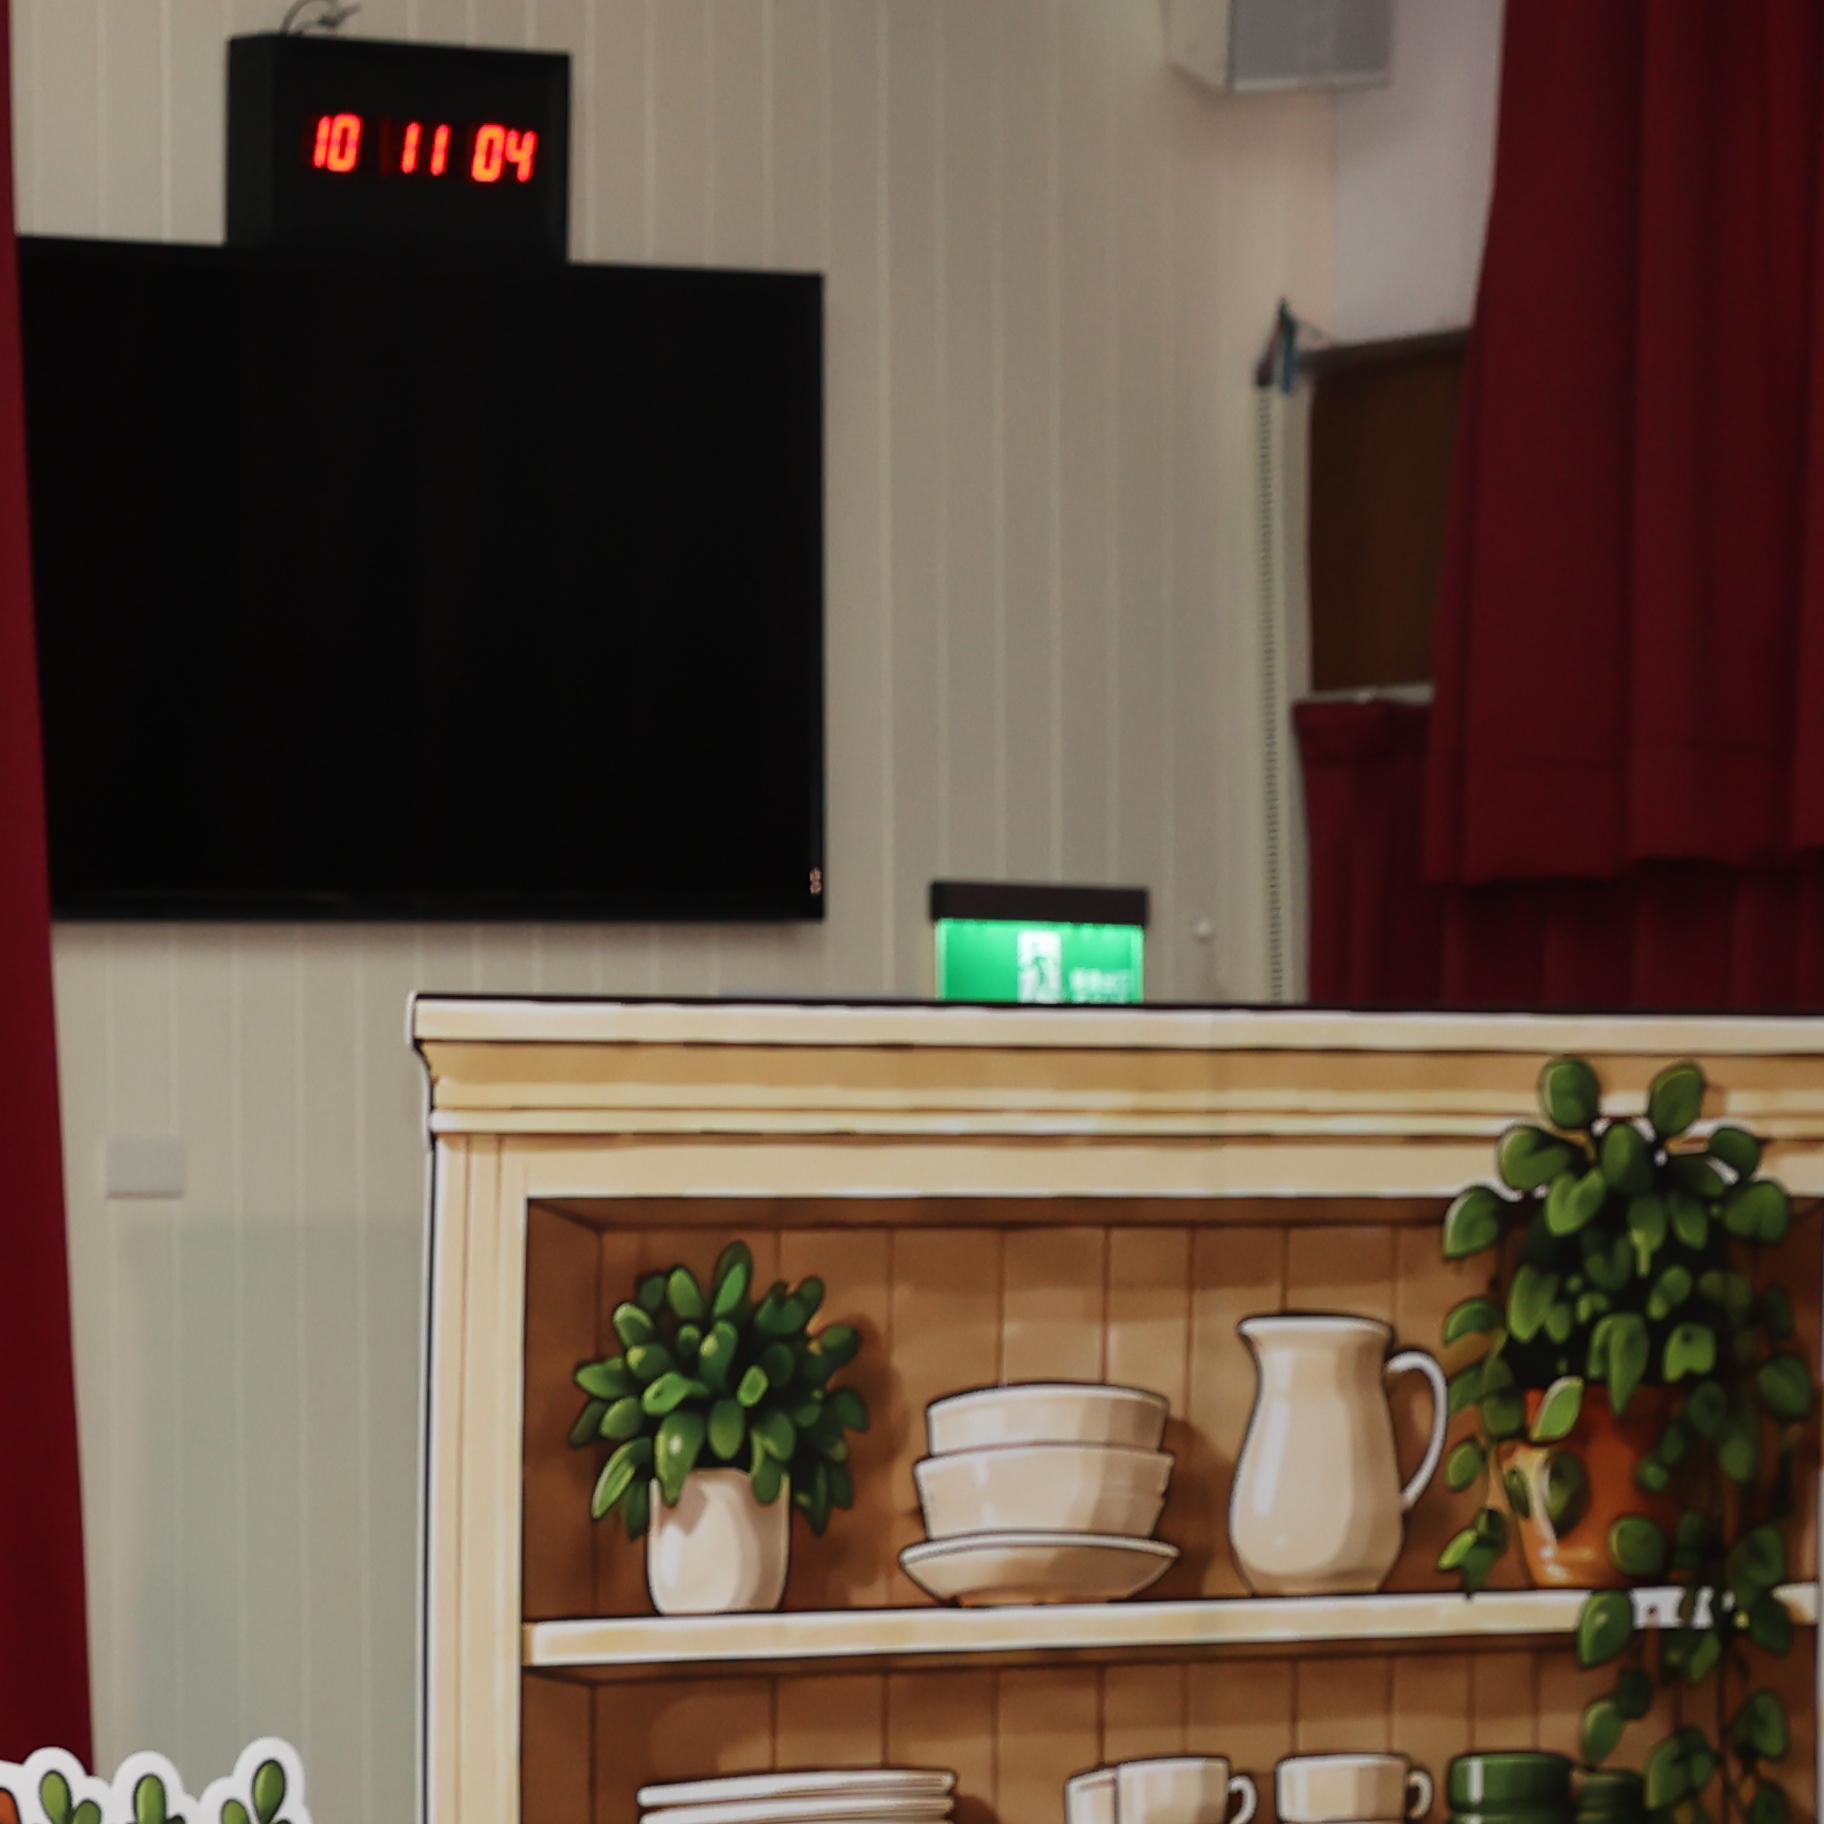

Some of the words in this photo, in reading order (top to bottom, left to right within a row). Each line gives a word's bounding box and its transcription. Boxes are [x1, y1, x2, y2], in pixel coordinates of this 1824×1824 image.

[312, 112, 361, 172] 10
[401, 121, 450, 177] 11
[470, 123, 538, 183] 04
